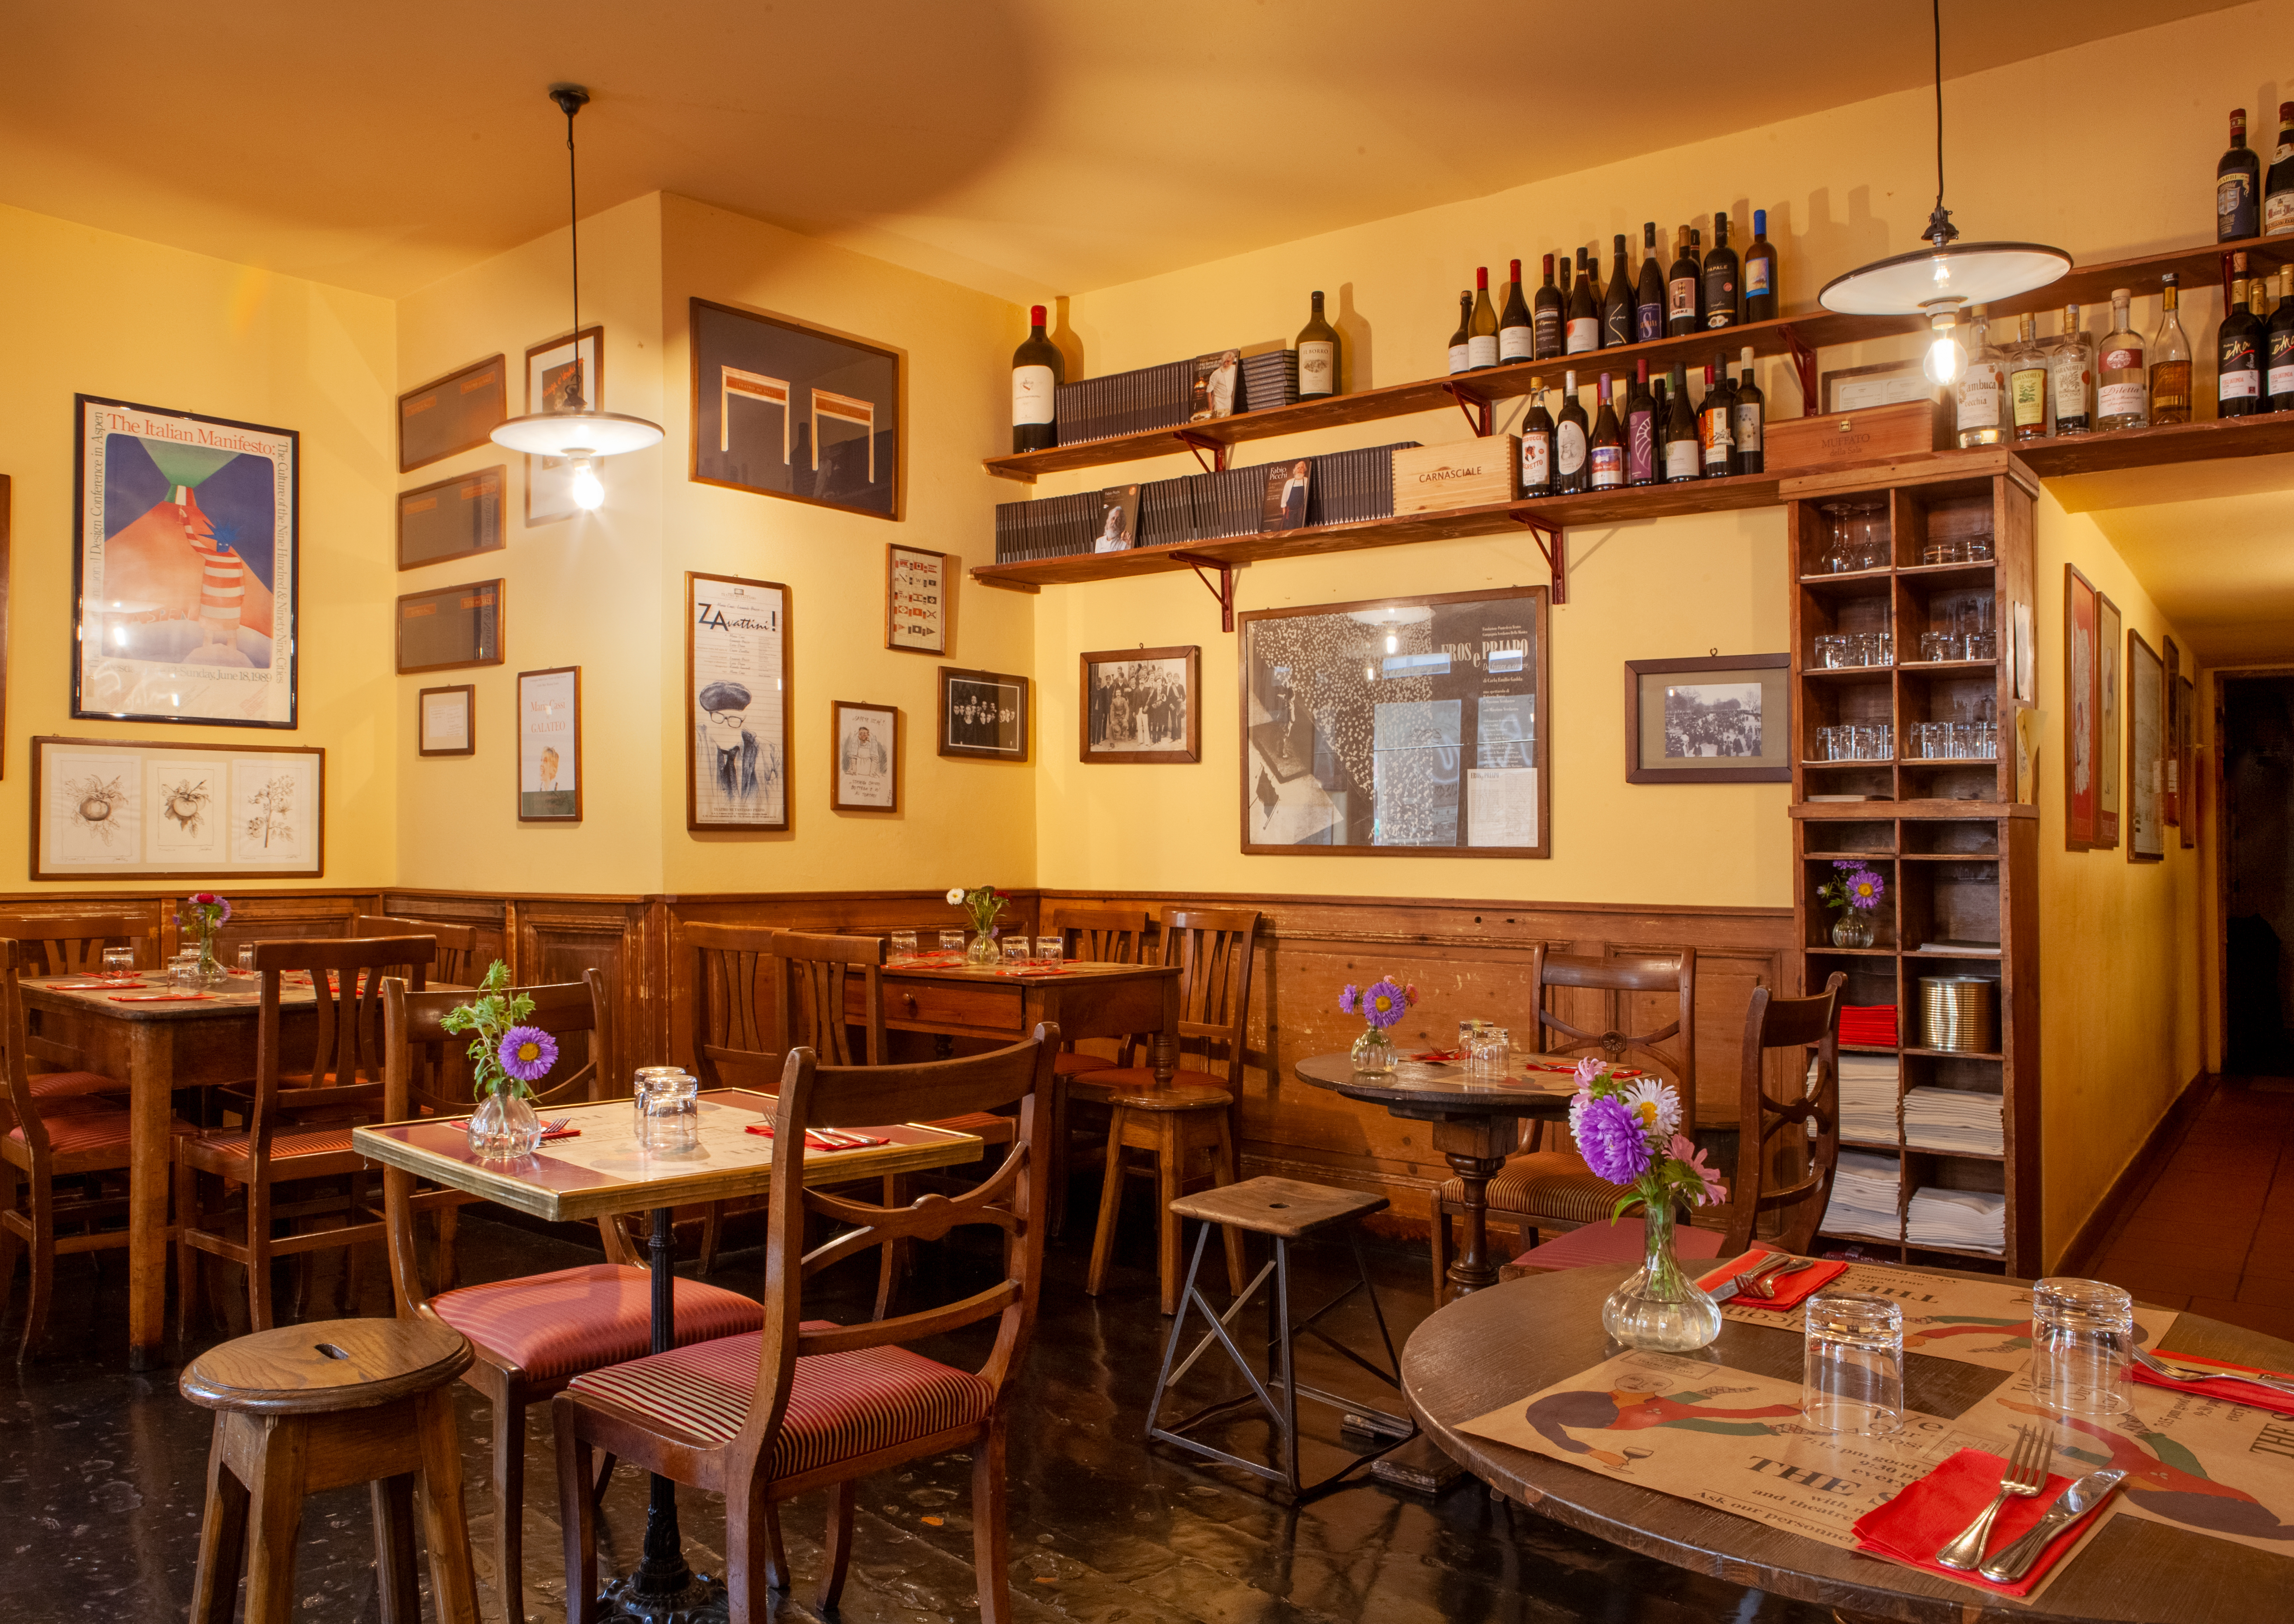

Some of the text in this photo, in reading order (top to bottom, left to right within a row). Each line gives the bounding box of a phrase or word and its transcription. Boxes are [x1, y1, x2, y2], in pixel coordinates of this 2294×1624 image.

[2055, 364, 2083, 373] SARANDREA
[2014, 373, 2041, 382] SARANDREA
[2100, 387, 2139, 398] Diletta
[91, 412, 103, 444] Aspen
[107, 413, 275, 455] The Italian Manifesto:
[1822, 434, 1870, 449] MUFFATO
[96, 448, 103, 458] in
[1848, 446, 1862, 455] Sala
[1270, 466, 1287, 474] Fabio
[1523, 459, 1543, 470] EGRETTO
[1270, 472, 1288, 480] Picchi
[1419, 467, 1482, 482] CARNASCIALE
[90, 461, 103, 516] Conference
[90, 521, 104, 554] Design
[275, 442, 288, 684] The Culture of the Nine Hundred & Ninety Nine Cities
[1441, 642, 1472, 662] EROS
[1473, 652, 1480, 667] e
[217, 669, 238, 680] June
[531, 721, 565, 733] GALATEO
[1853, 1284, 1938, 1304] THE
[2153, 1416, 2174, 1428] 7:15
[2173, 1397, 2192, 1411] good
[1802, 1436, 1918, 1470] 7:15 pm good
[1859, 1460, 1897, 1473] 9:30
[1744, 1455, 1862, 1497] THE
[1751, 1489, 1787, 1502] and
[1789, 1498, 1853, 1522] theatre
[1811, 1495, 1849, 1510] with
[1693, 1491, 1856, 1544] Ask our personnel
